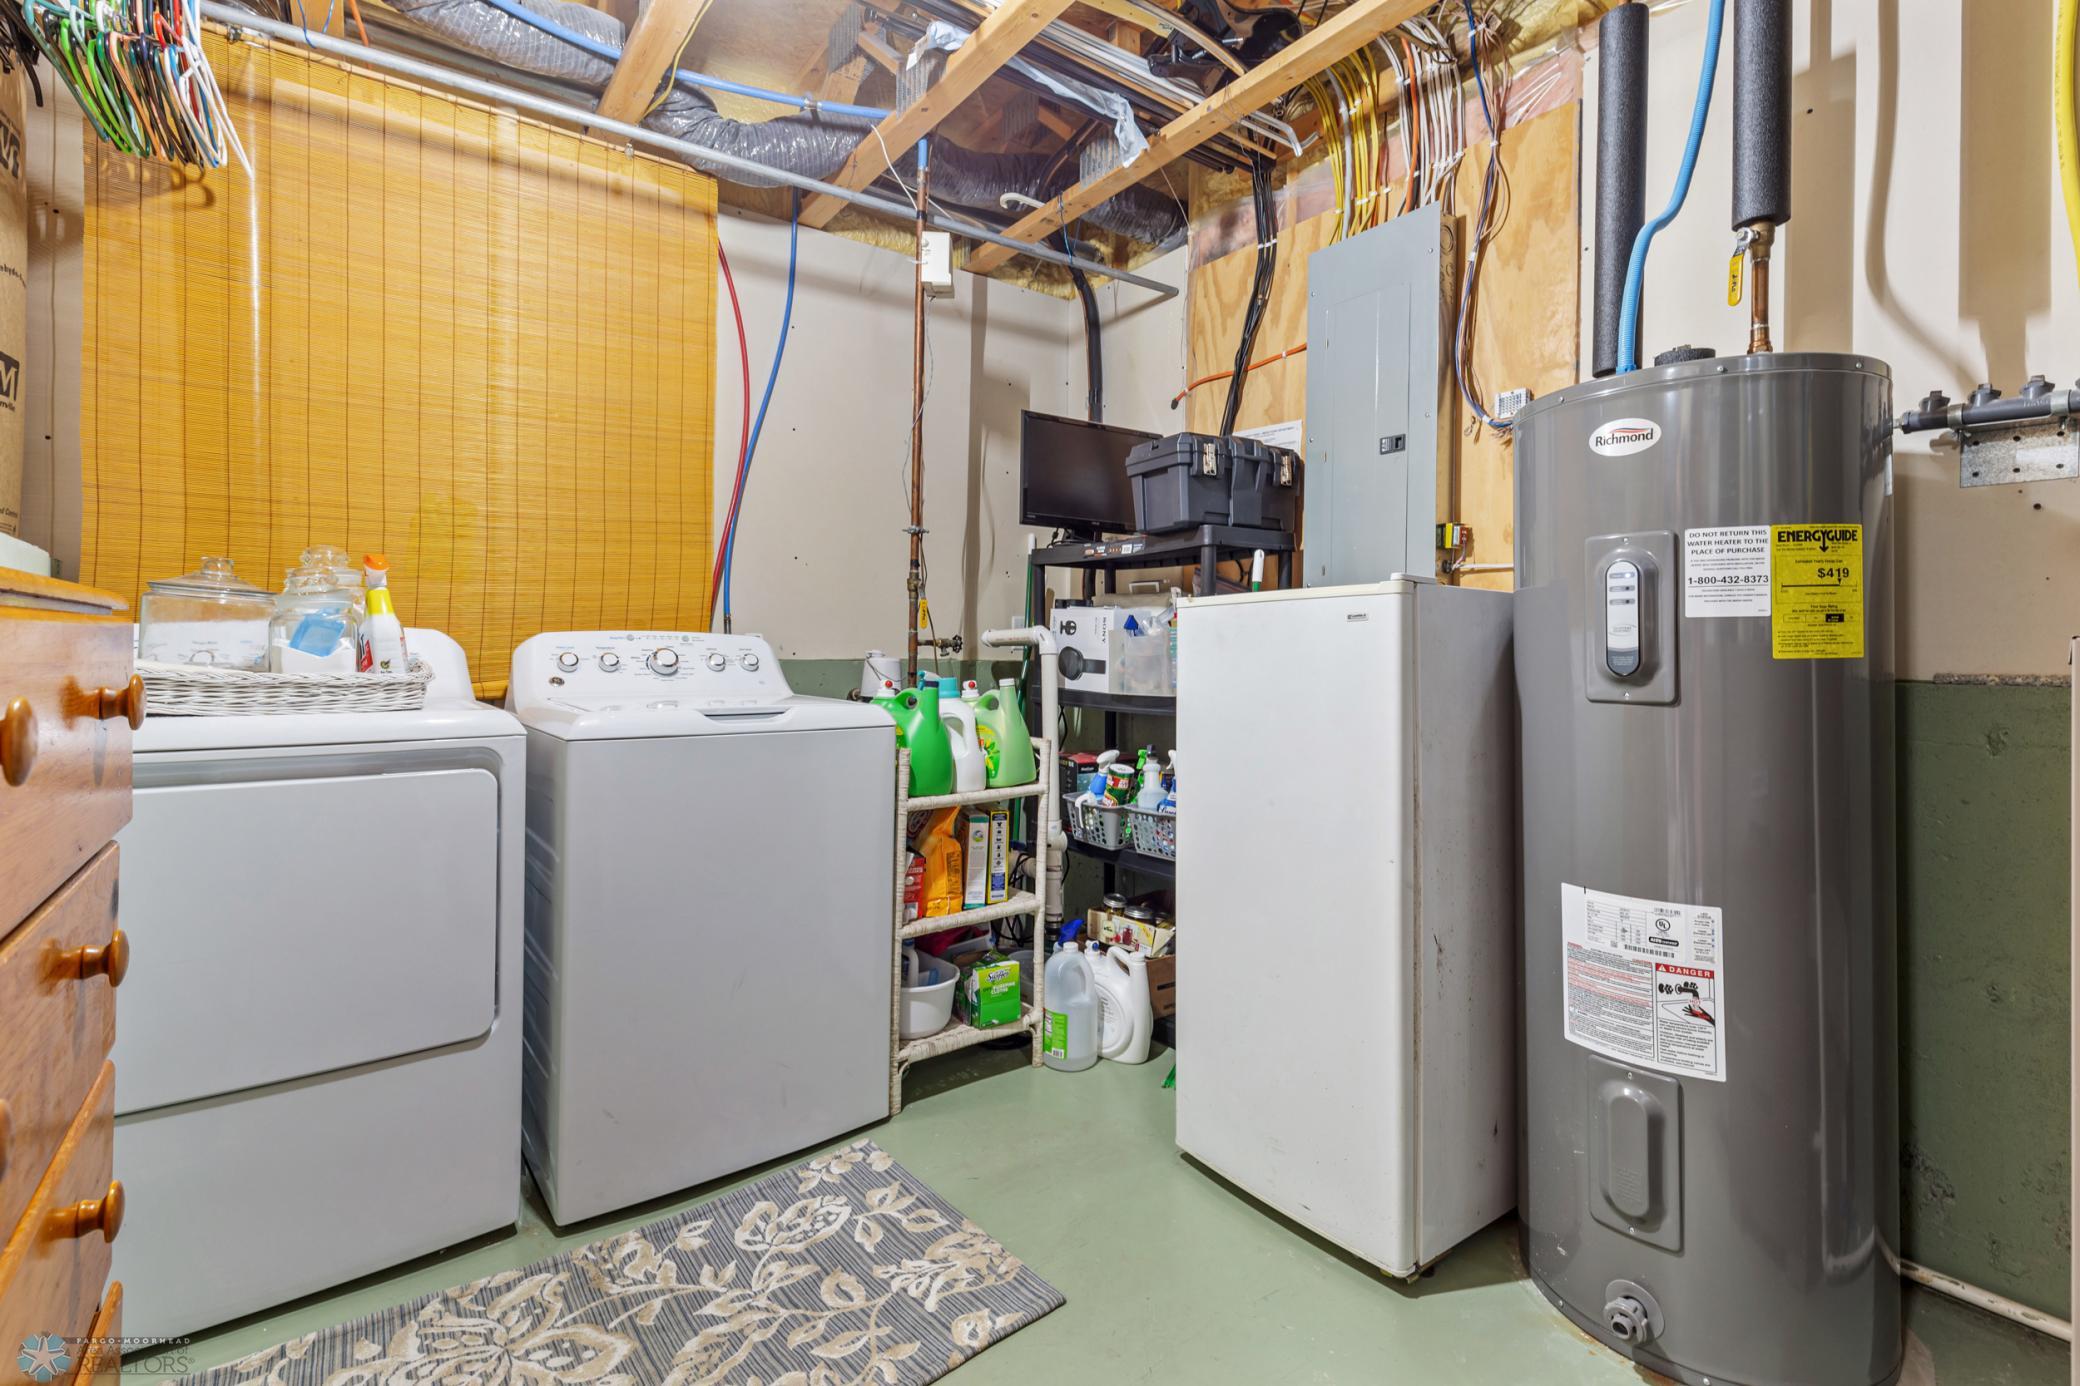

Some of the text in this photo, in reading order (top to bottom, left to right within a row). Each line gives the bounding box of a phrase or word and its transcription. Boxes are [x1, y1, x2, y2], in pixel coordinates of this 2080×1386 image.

[1595, 428, 1654, 446] Richmond
[1777, 529, 1858, 543] ENERGYGUIDE
[1817, 567, 1850, 579] $419
[1687, 575, 1769, 585] 1-800-432-8373
[1669, 966, 1711, 978] DANGER
